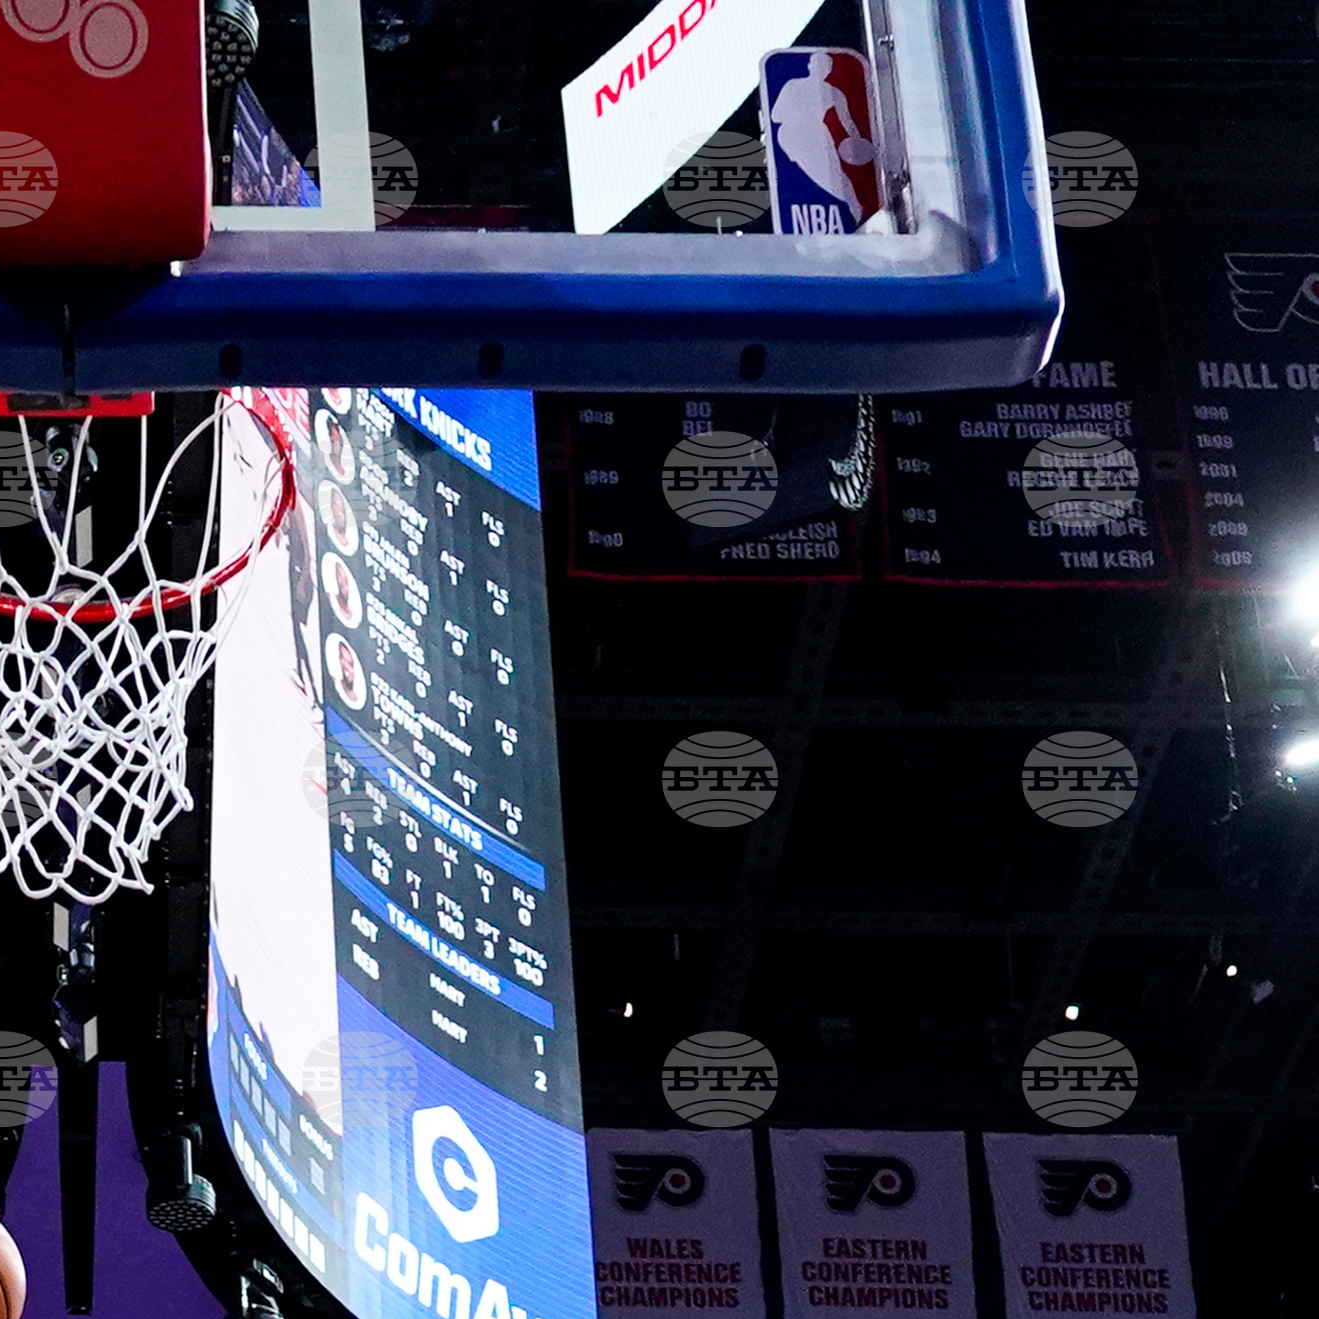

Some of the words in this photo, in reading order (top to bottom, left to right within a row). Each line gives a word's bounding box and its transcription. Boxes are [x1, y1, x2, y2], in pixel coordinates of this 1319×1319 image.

[595, 0, 716, 118] MIDD
[790, 204, 845, 235] NBA
[1197, 361, 1279, 390] HALL
[419, 395, 493, 471] KNICKS
[386, 767, 432, 817] TEAM
[431, 803, 484, 851] STATS
[474, 863, 496, 887] TO
[512, 886, 537, 910] FLS
[386, 902, 432, 951] TEAM
[431, 936, 501, 995] LEADERS
[533, 1070, 548, 1092] 2
[626, 1238, 704, 1260] WALES
[823, 1238, 928, 1261] EASTERN
[1040, 1241, 1147, 1265] EASTERN
[594, 1262, 742, 1286] CONFERENCE
[801, 1261, 953, 1286] CONFERENCE
[1021, 1265, 1172, 1291] CONFERENCE
[599, 1287, 741, 1309] CHAMPIONS
[808, 1286, 950, 1310] CHAMPIONS
[1028, 1290, 1170, 1315] CHAMPIONS
